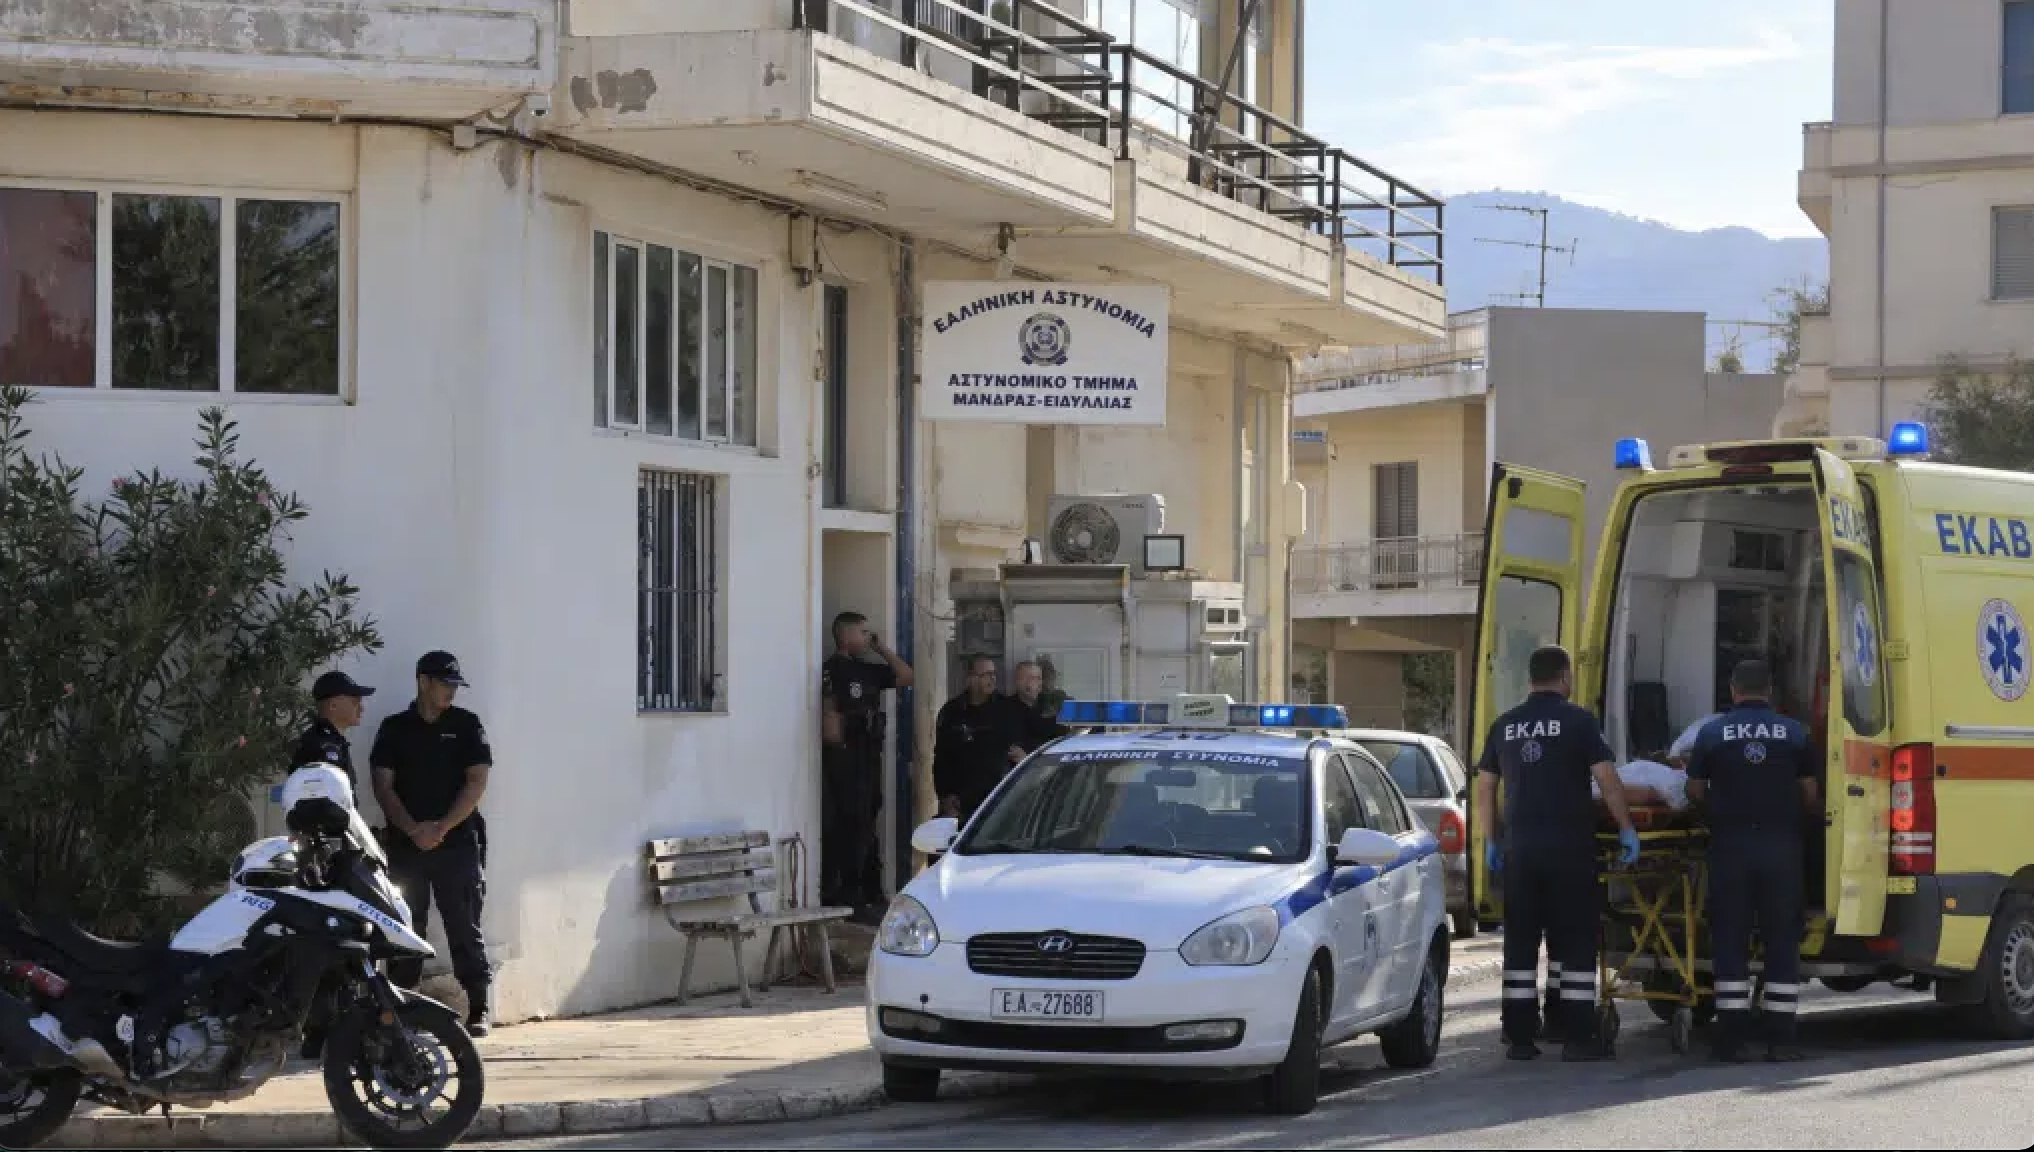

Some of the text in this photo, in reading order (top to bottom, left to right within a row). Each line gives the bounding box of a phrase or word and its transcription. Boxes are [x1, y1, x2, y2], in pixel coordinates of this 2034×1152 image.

[948, 373, 1138, 391] ΑΣΤΥΝΟΜΙΚΟ ΤΜΗΜΑ
[953, 393, 1133, 409] ΜΑΝΔΡΑΣ-ΕΙΔΥΛΛΙΑΣ
[1935, 513, 2033, 558] ΕΚΑΒ
[1504, 719, 1561, 741] ΕΚΑΒ
[1723, 723, 1788, 741] ΕΚΑΒ
